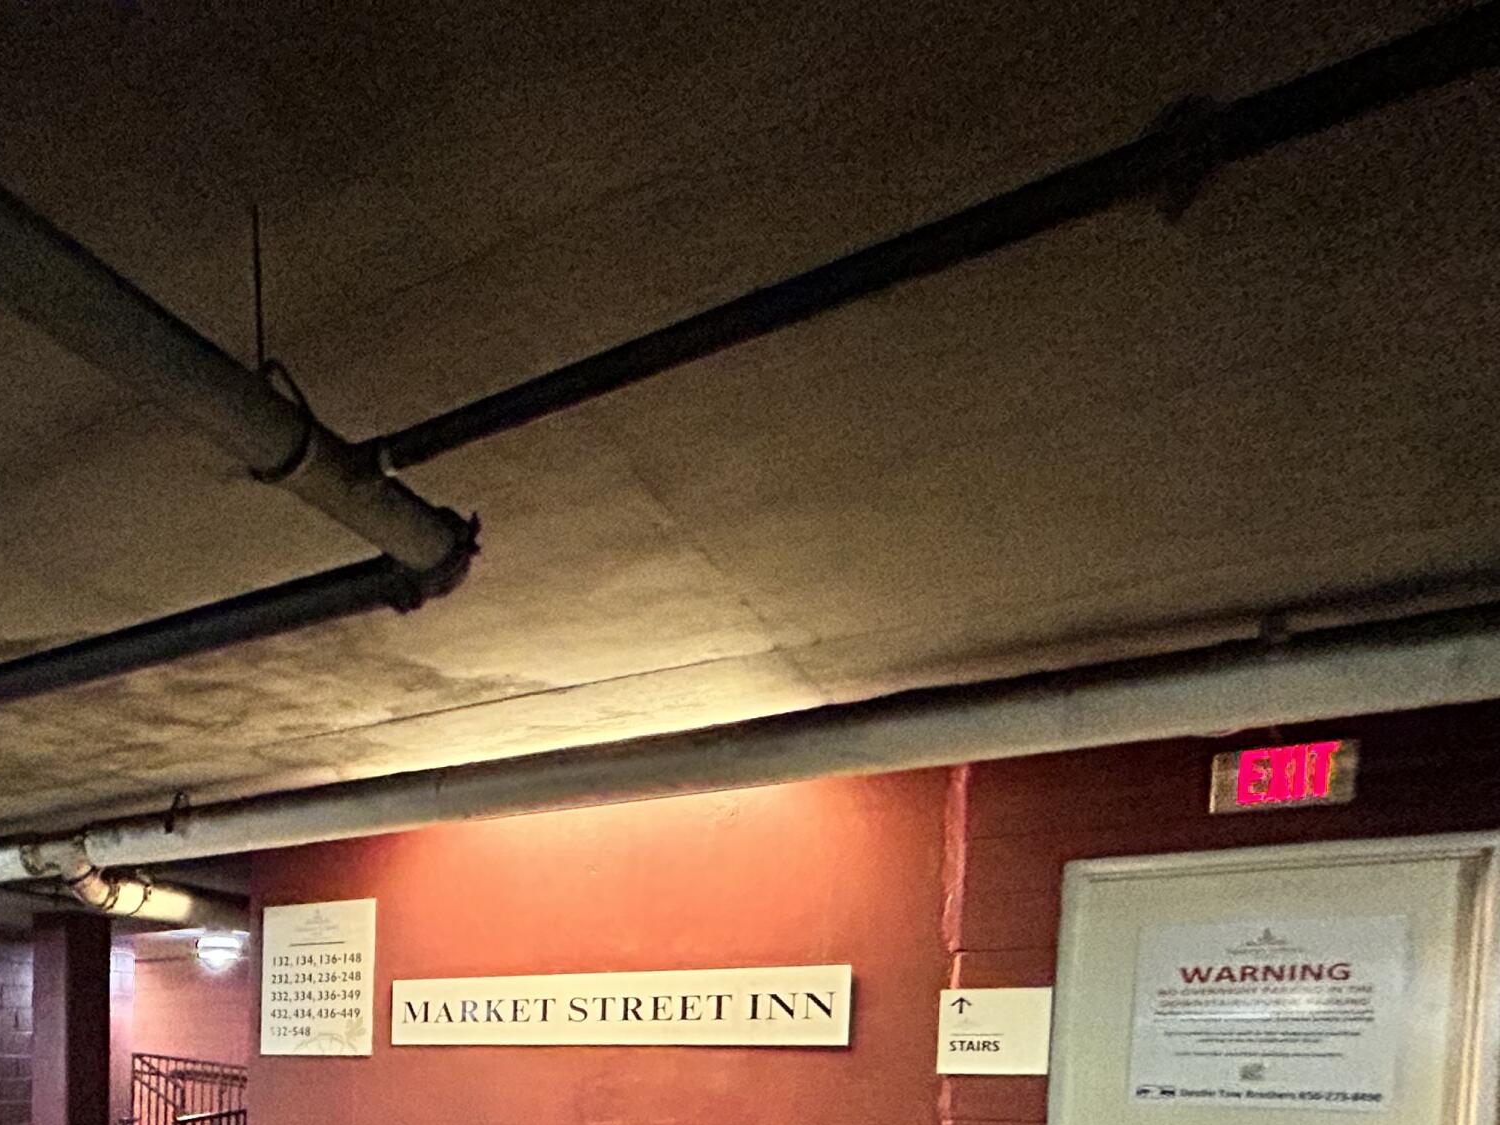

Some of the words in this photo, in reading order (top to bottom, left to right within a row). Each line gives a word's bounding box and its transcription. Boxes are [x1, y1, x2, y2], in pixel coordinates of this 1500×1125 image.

[1236, 740, 1341, 805] EXIT
[319, 952, 362, 965] 136-148
[295, 973, 316, 985] 234,
[318, 971, 362, 983] 236-248
[1180, 963, 1353, 983] WARNING
[271, 991, 292, 1003] 332,
[294, 990, 316, 1003] 334,
[317, 989, 361, 1002] 336-349
[293, 1008, 315, 1020] 434,
[317, 1007, 361, 1019] 436-449
[403, 998, 557, 1024] MARKET
[567, 993, 734, 1023] STREET
[746, 991, 837, 1020] INN
[948, 1040, 1000, 1053] STAIRS
